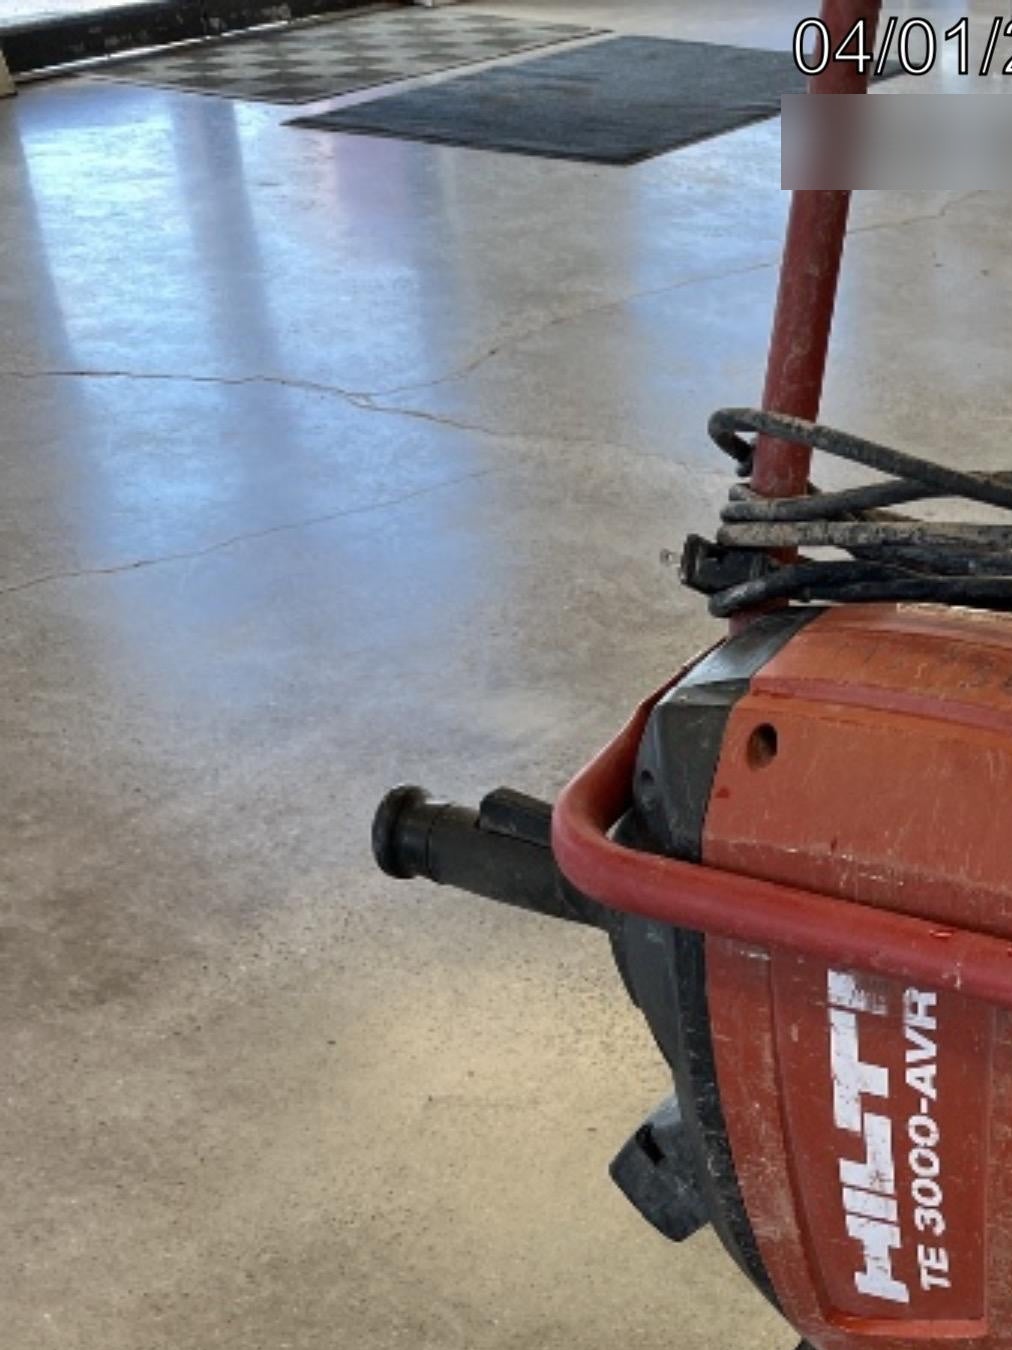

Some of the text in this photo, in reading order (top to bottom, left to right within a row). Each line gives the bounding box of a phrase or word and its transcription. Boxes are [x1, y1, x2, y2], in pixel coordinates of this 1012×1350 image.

[827, 967, 910, 1303] HILTI
[903, 986, 950, 1291] TE 3000-AVR
